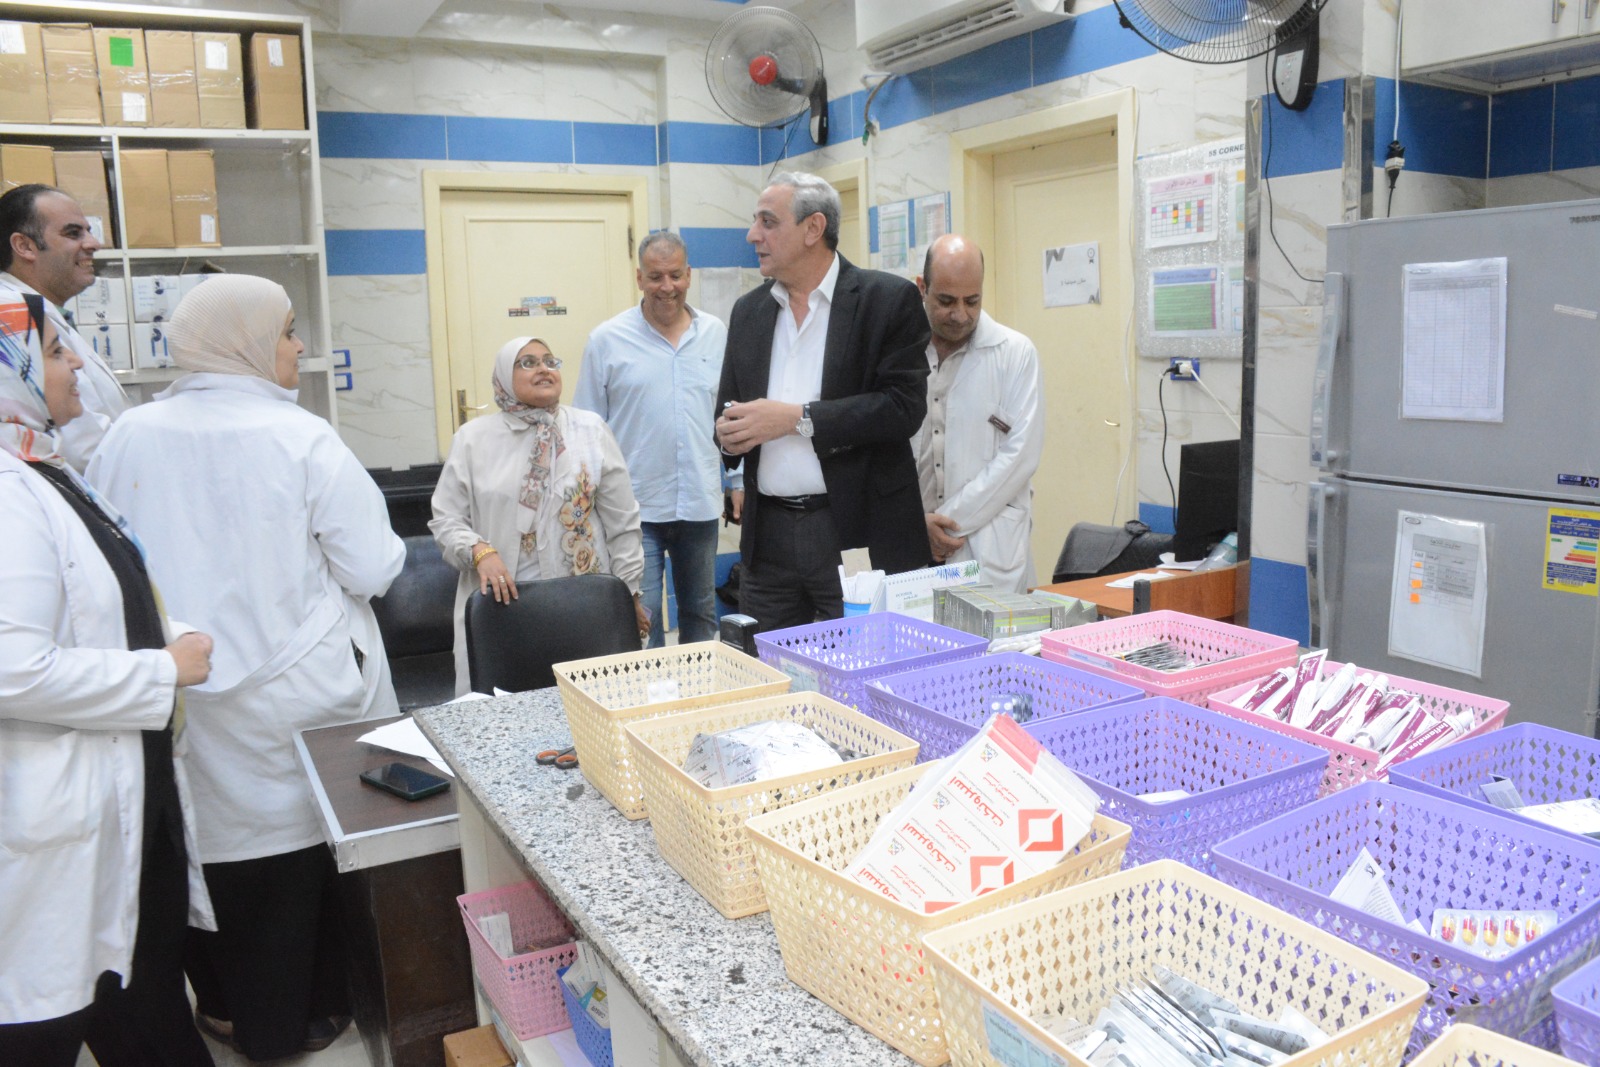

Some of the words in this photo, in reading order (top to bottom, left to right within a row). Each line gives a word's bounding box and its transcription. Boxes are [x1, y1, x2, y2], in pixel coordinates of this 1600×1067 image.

[1408, 722, 1449, 751] Inflamolox
[950, 777, 1003, 826] أسبروتكت
[904, 824, 956, 872] أسبروتكت
